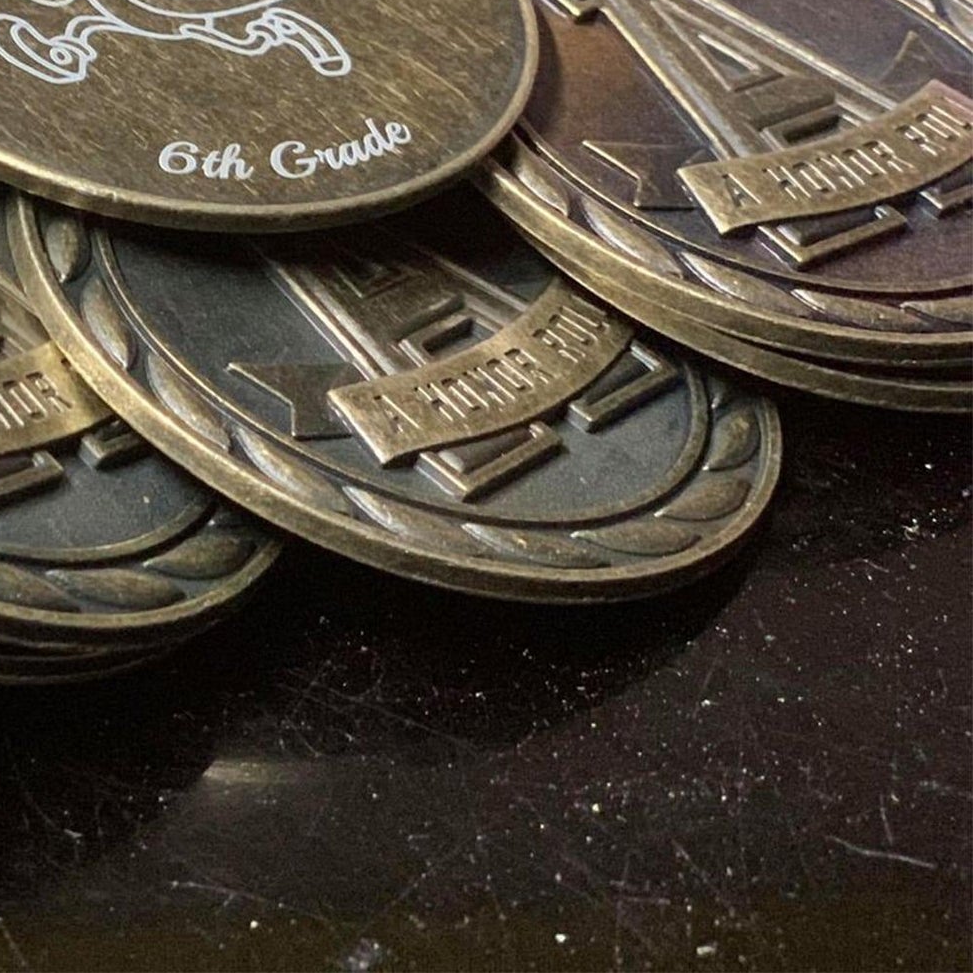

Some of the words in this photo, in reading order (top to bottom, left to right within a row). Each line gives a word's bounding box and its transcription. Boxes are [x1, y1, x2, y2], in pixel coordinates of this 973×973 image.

[157, 141, 253, 180] 6th
[270, 118, 412, 180] Grade
[721, 172, 763, 208] A
[761, 140, 915, 201] HONOR
[373, 394, 423, 433] A
[414, 347, 560, 422] HONOR
